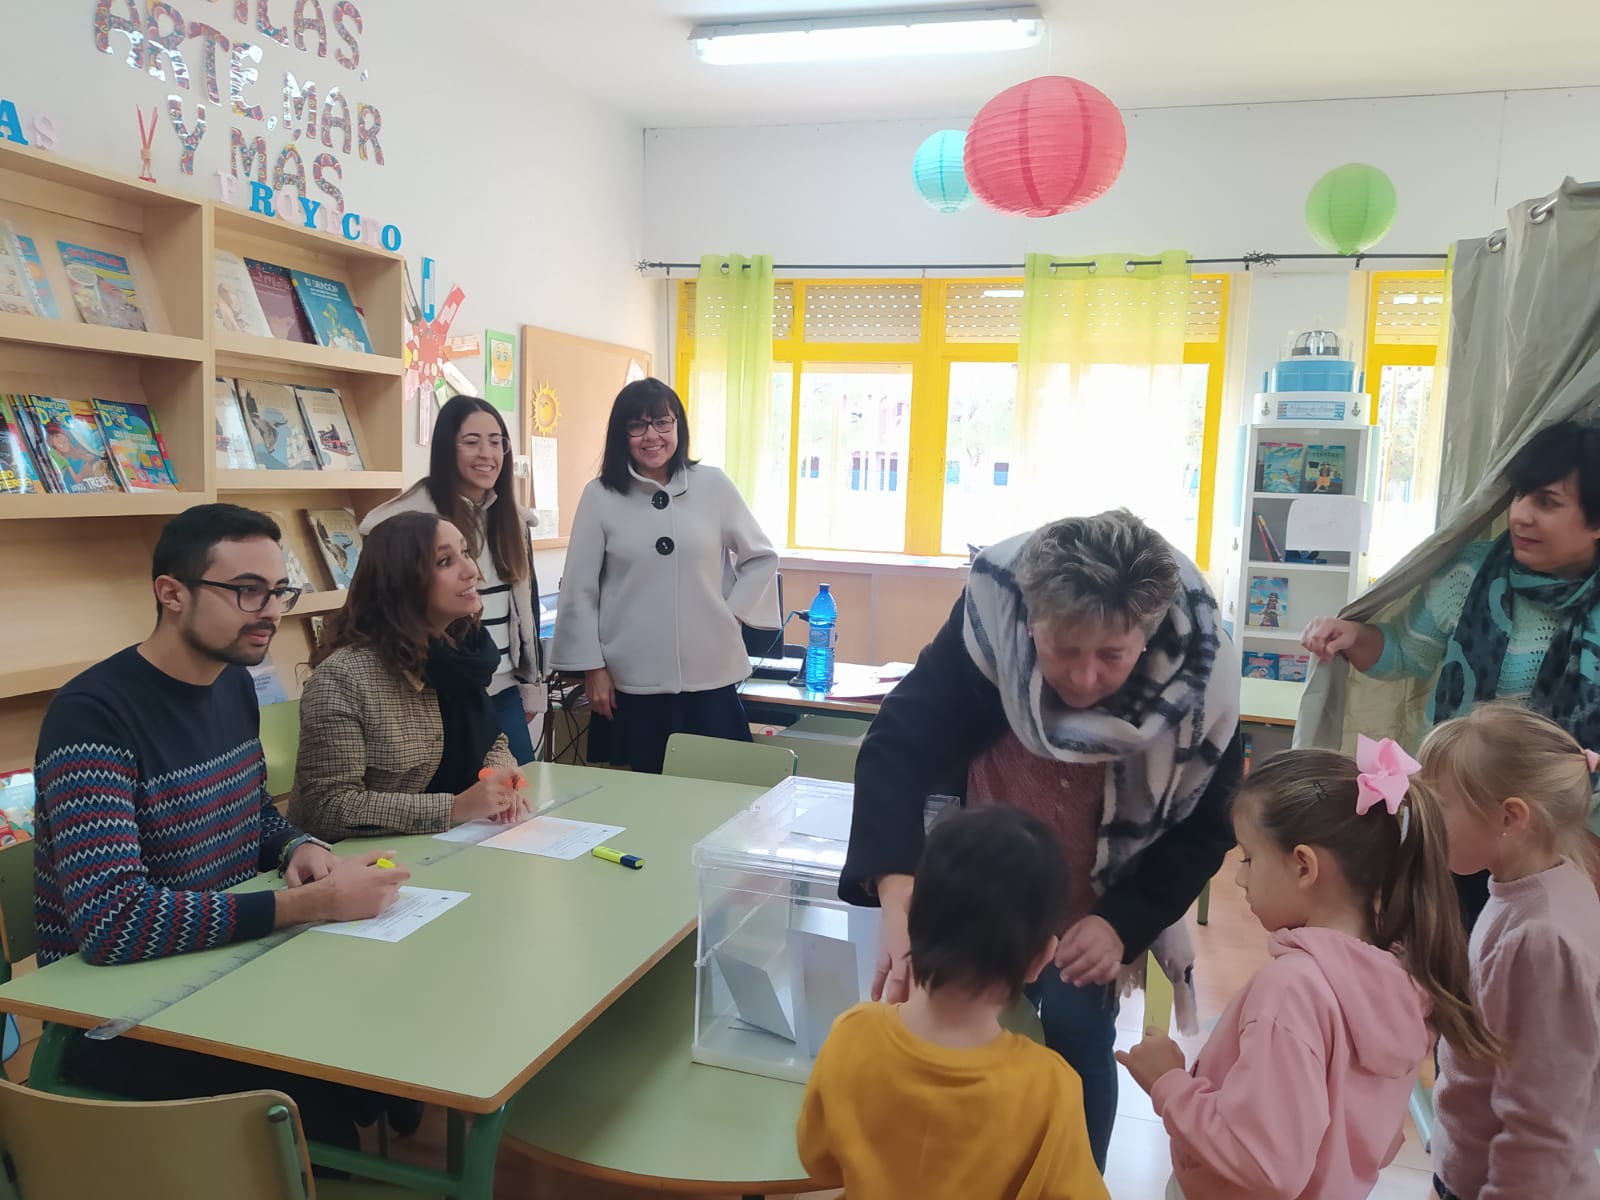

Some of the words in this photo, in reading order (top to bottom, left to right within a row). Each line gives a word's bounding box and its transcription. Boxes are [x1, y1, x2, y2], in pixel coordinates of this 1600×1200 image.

[167, 94, 207, 176] Y
[283, 71, 385, 166] MAR
[215, 170, 402, 252] PROYECTO
